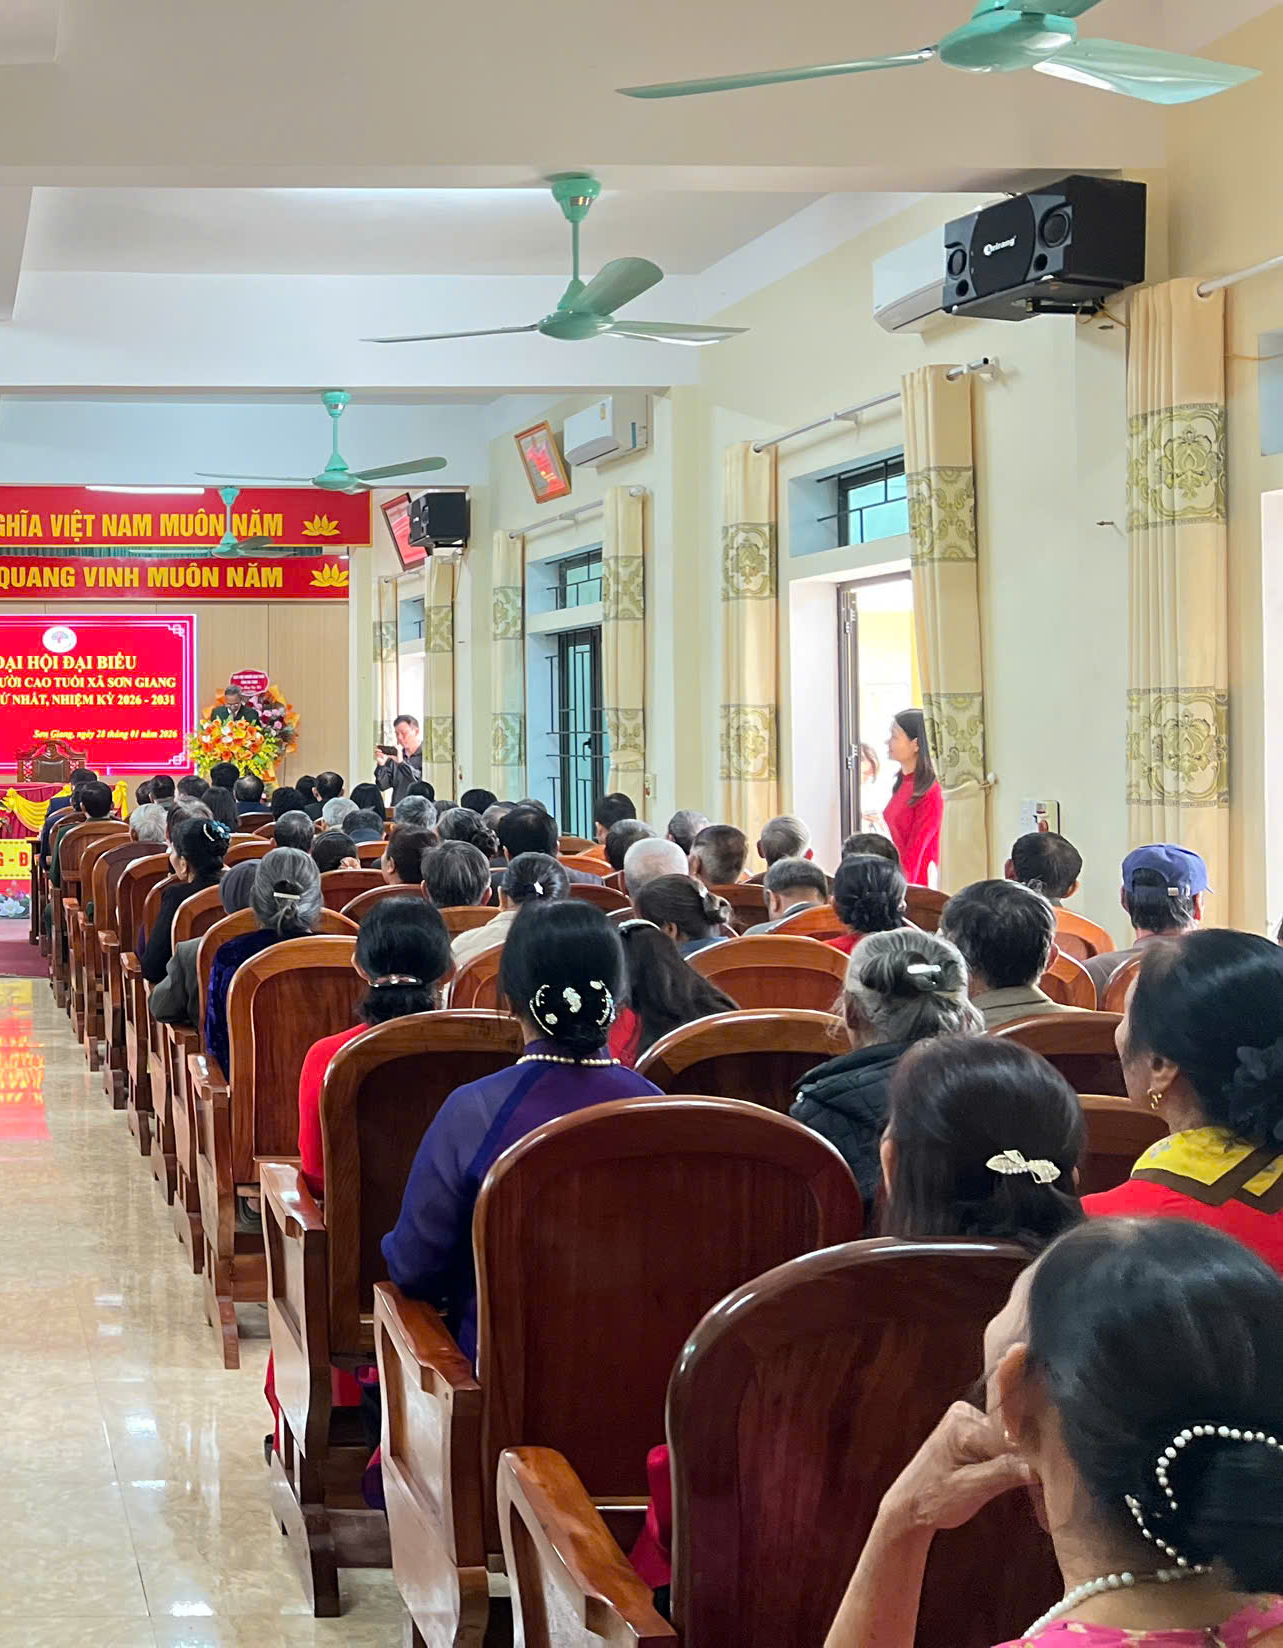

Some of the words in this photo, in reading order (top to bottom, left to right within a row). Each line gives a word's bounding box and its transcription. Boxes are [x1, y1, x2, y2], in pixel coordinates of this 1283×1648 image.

[50, 509, 96, 542] VIỆT
[102, 513, 152, 537] NAM
[160, 508, 225, 537] MUÔN
[232, 508, 283, 537] NĂM
[83, 566, 139, 588] VINH
[148, 562, 219, 588] MUÔN
[227, 563, 283, 588] NĂM
[27, 653, 59, 672] HỘI
[62, 655, 93, 673] ĐẠI
[96, 651, 137, 670] BIỂU
[24, 677, 52, 688] CAO
[53, 675, 85, 688] TUỔI
[87, 675, 105, 688] XÃ
[107, 676, 132, 688] SƠN
[135, 677, 176, 688] GIANG
[51, 693, 93, 707] NHIỆM
[117, 694, 142, 705] 2026
[151, 694, 175, 705] 2031
[159, 729, 177, 739] 2026
